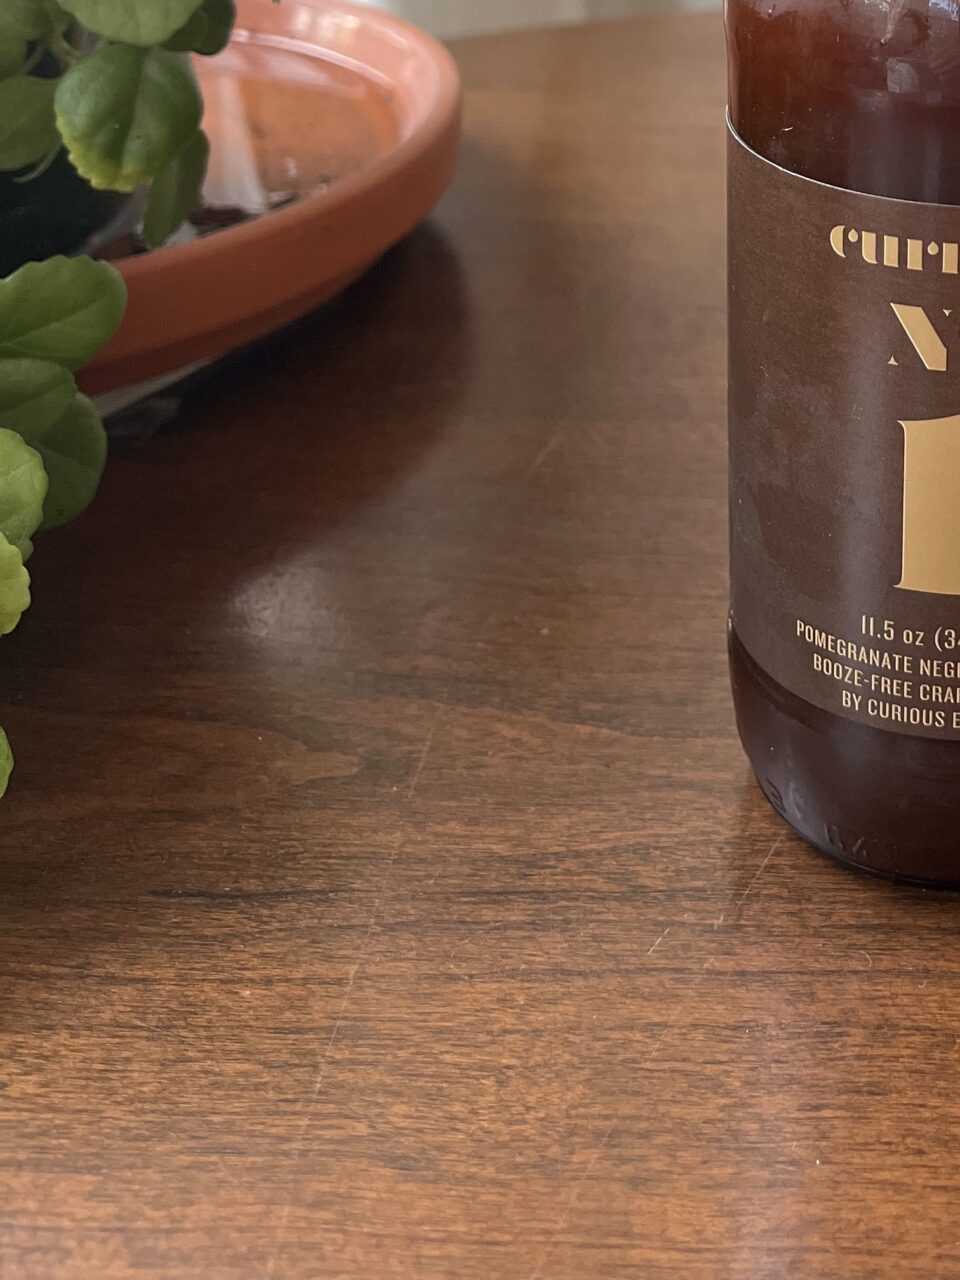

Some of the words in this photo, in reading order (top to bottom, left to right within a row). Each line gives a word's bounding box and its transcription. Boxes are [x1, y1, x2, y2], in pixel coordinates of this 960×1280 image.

[796, 619, 913, 674] POMEGRANATE
[861, 614, 895, 641] 11.5
[813, 653, 913, 699] BOOZE-FREE
[842, 689, 862, 711] BY
[867, 698, 946, 727] CURIOUS
